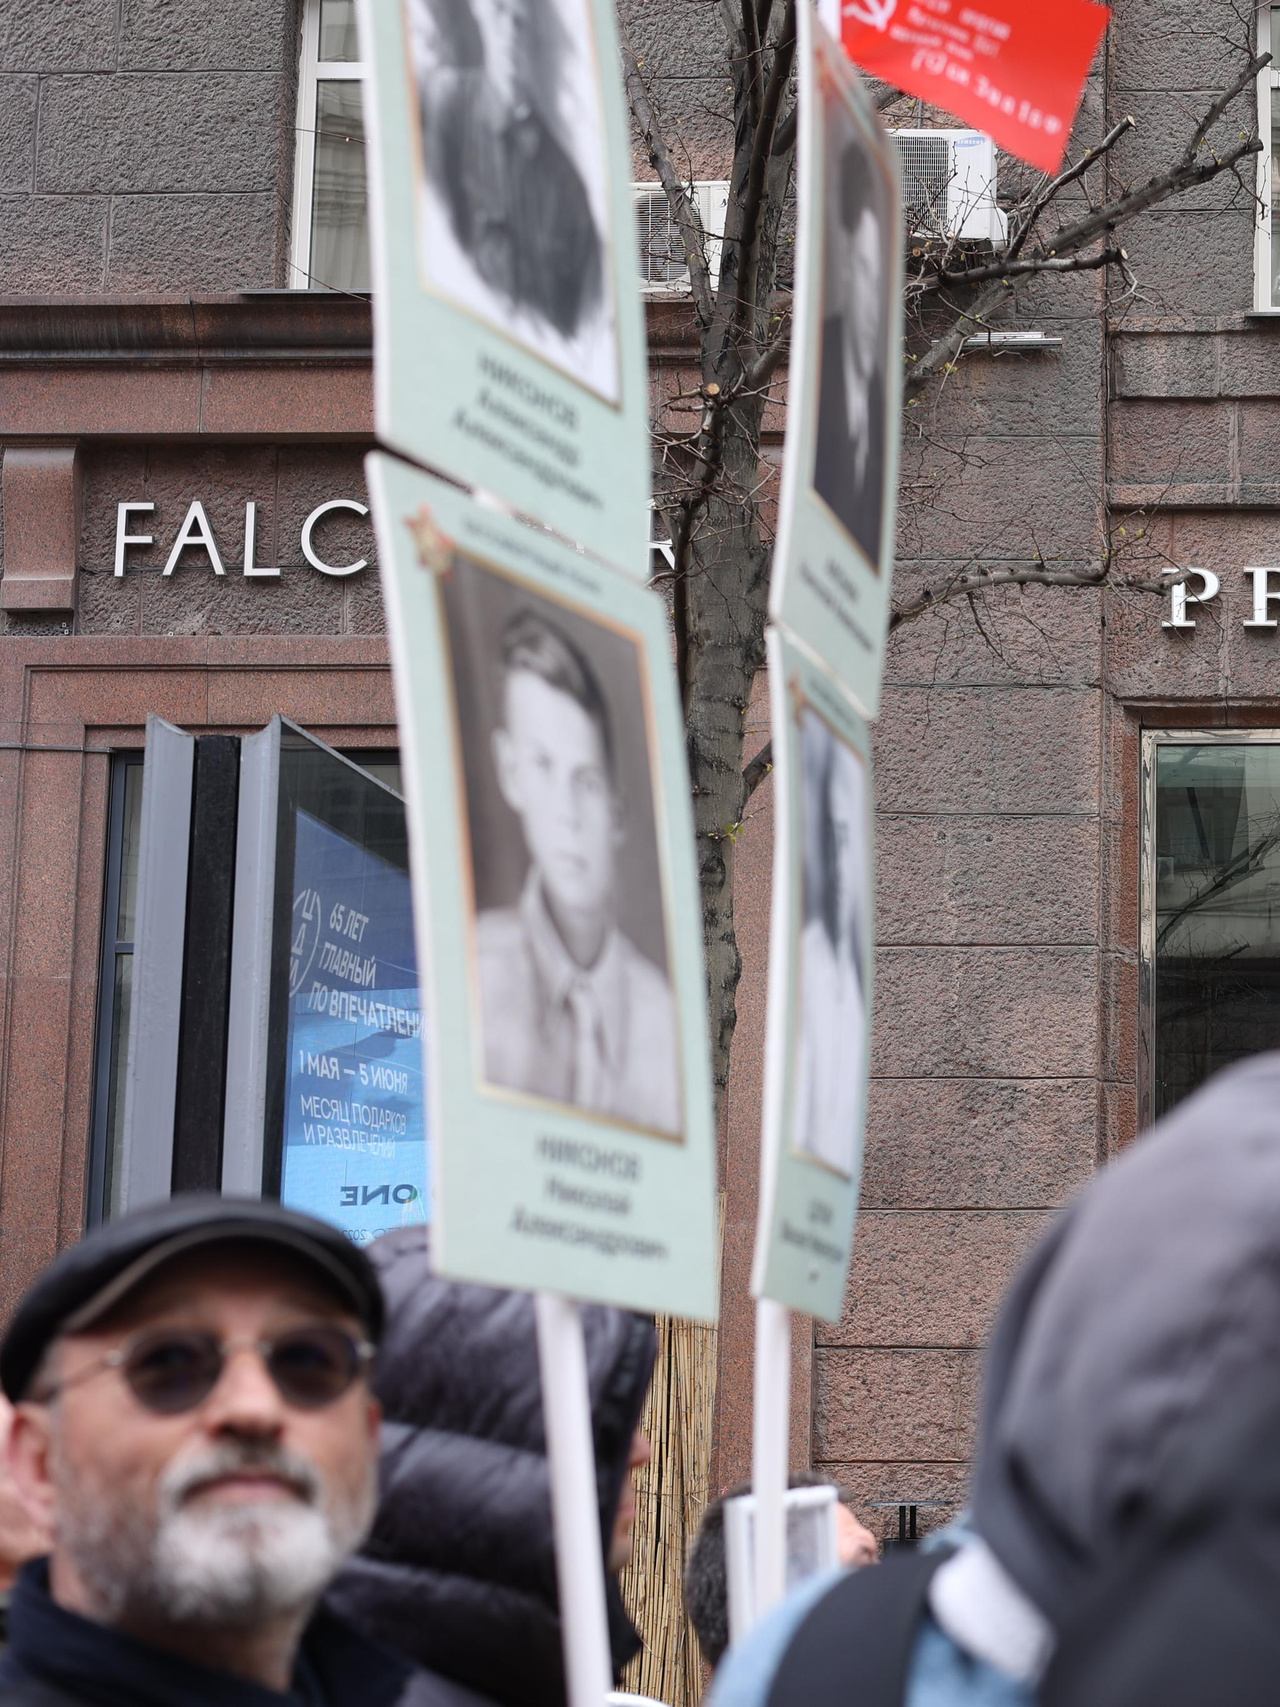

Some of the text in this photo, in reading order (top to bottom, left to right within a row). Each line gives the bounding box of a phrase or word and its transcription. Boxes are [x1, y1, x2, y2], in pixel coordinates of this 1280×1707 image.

[330, 902, 369, 943] 65 ЛЕТ
[318, 941, 377, 989] ГЛАВНЫЙ
[308, 980, 328, 1012] ПО
[307, 1052, 340, 1081] МАЯ
[359, 1063, 369, 1086] 5
[371, 1065, 408, 1095] ИЮНЯ
[300, 1094, 406, 1135] МЕСЯЦ ПОДАРКОВ
[303, 1122, 396, 1159] И РАЗВЛЕЧЕНИЙ
